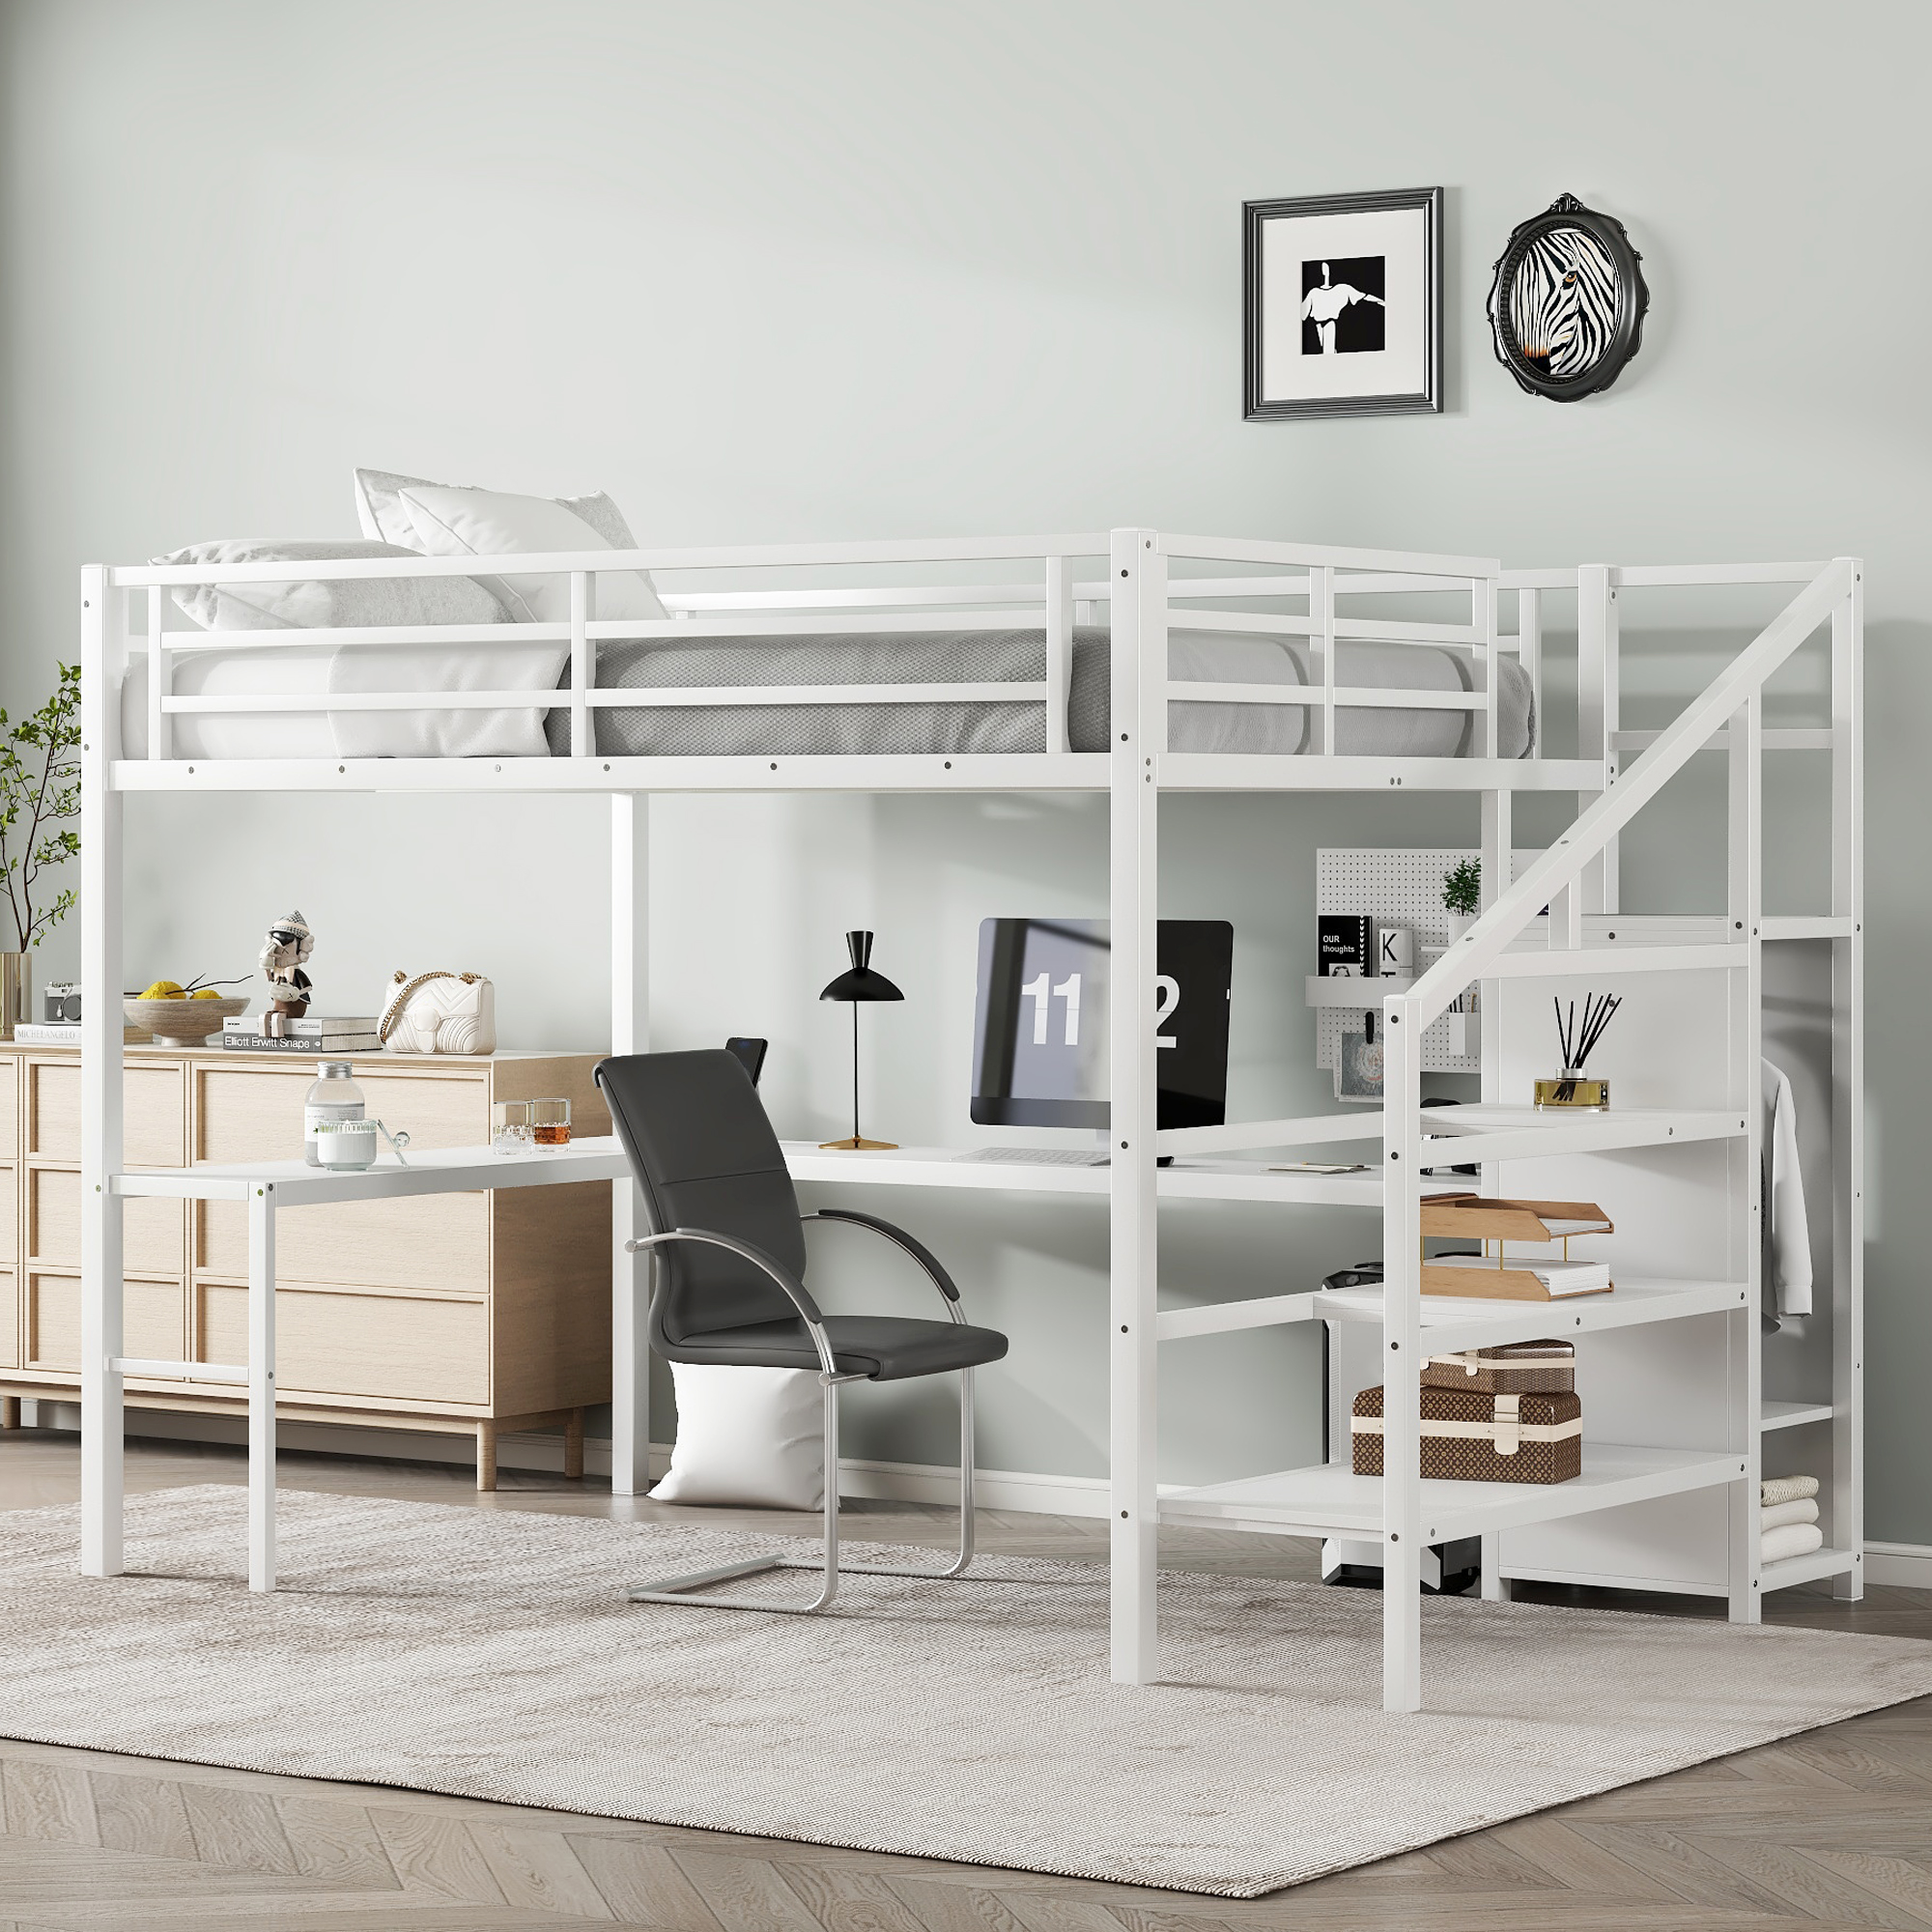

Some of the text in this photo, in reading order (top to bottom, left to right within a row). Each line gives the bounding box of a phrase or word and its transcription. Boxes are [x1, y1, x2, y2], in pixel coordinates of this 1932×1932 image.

[1322, 945, 1355, 954] thoughts
[1382, 933, 1398, 961] K
[1022, 972, 1081, 1045] 11
[16, 1029, 75, 1040] MICHELANGELO
[224, 1036, 249, 1047] Elliott
[251, 1037, 277, 1048] Erwitt
